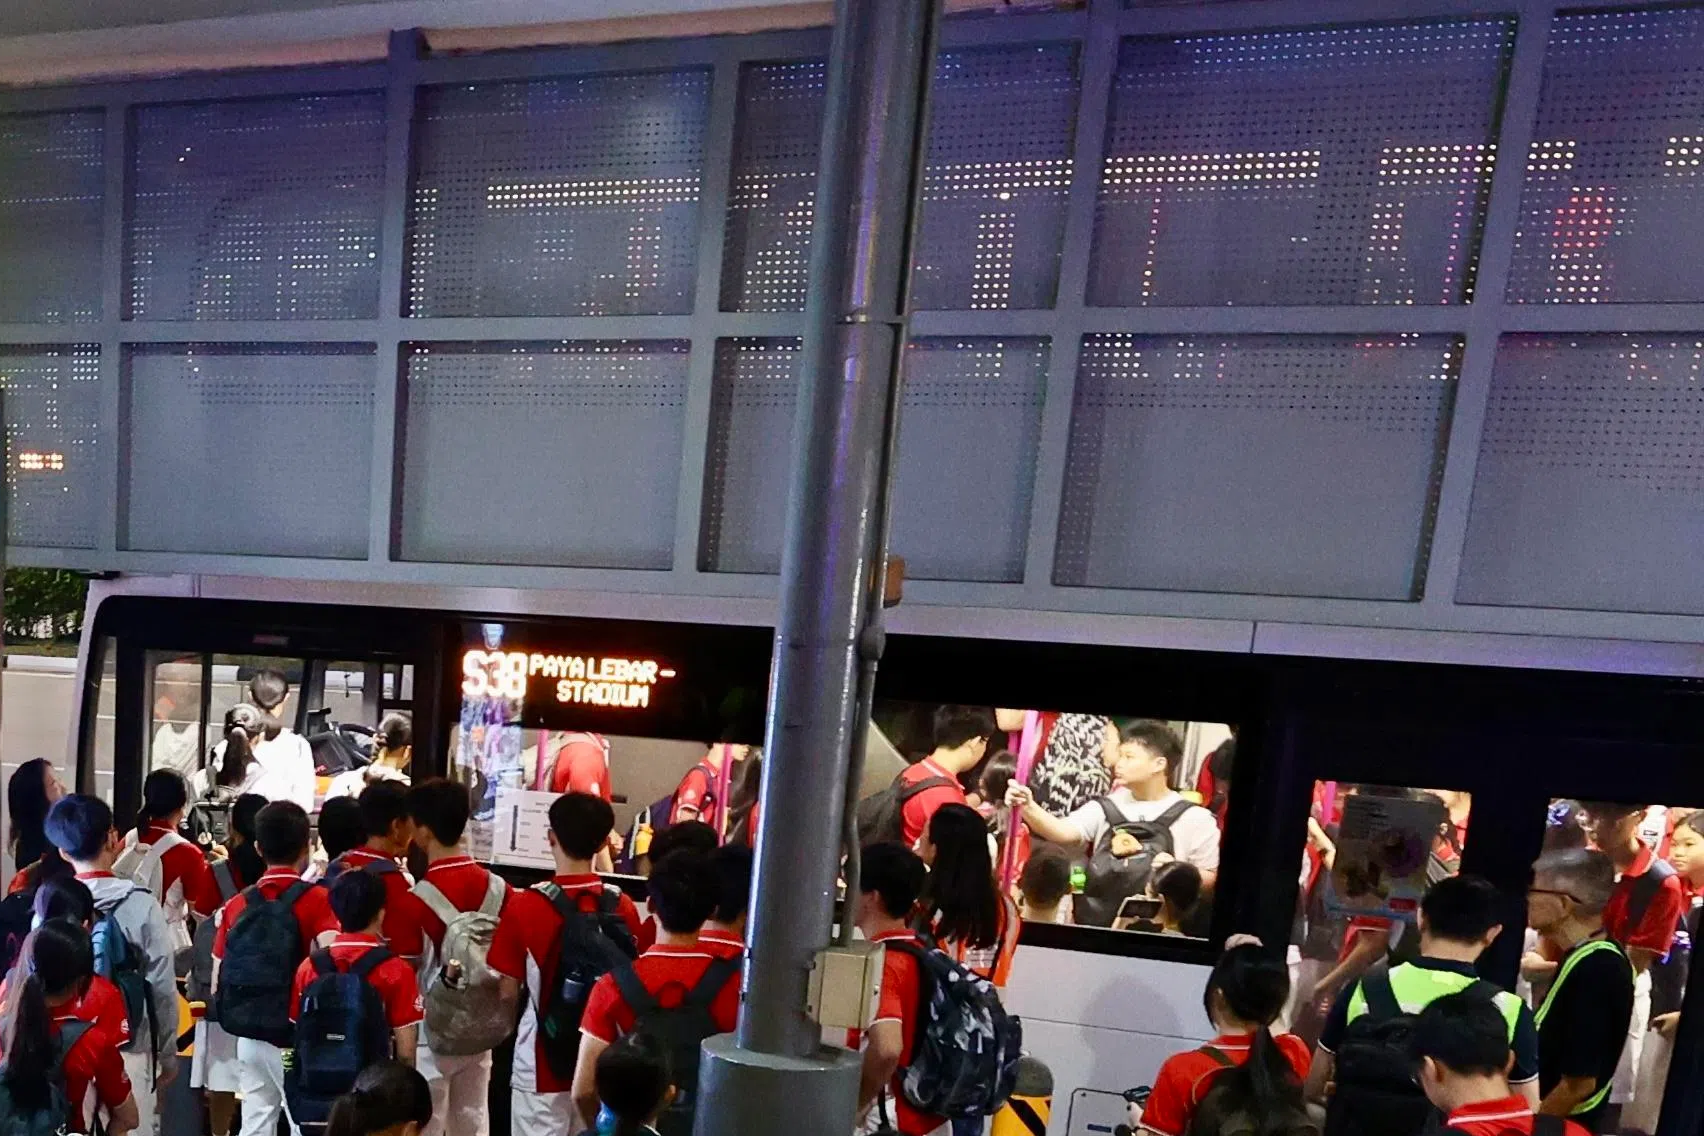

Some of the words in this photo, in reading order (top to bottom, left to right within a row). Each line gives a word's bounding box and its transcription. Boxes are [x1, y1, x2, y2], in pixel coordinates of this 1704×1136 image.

[462, 650, 528, 698] S38
[529, 653, 585, 678] PAYA
[556, 679, 650, 708] STADIUM
